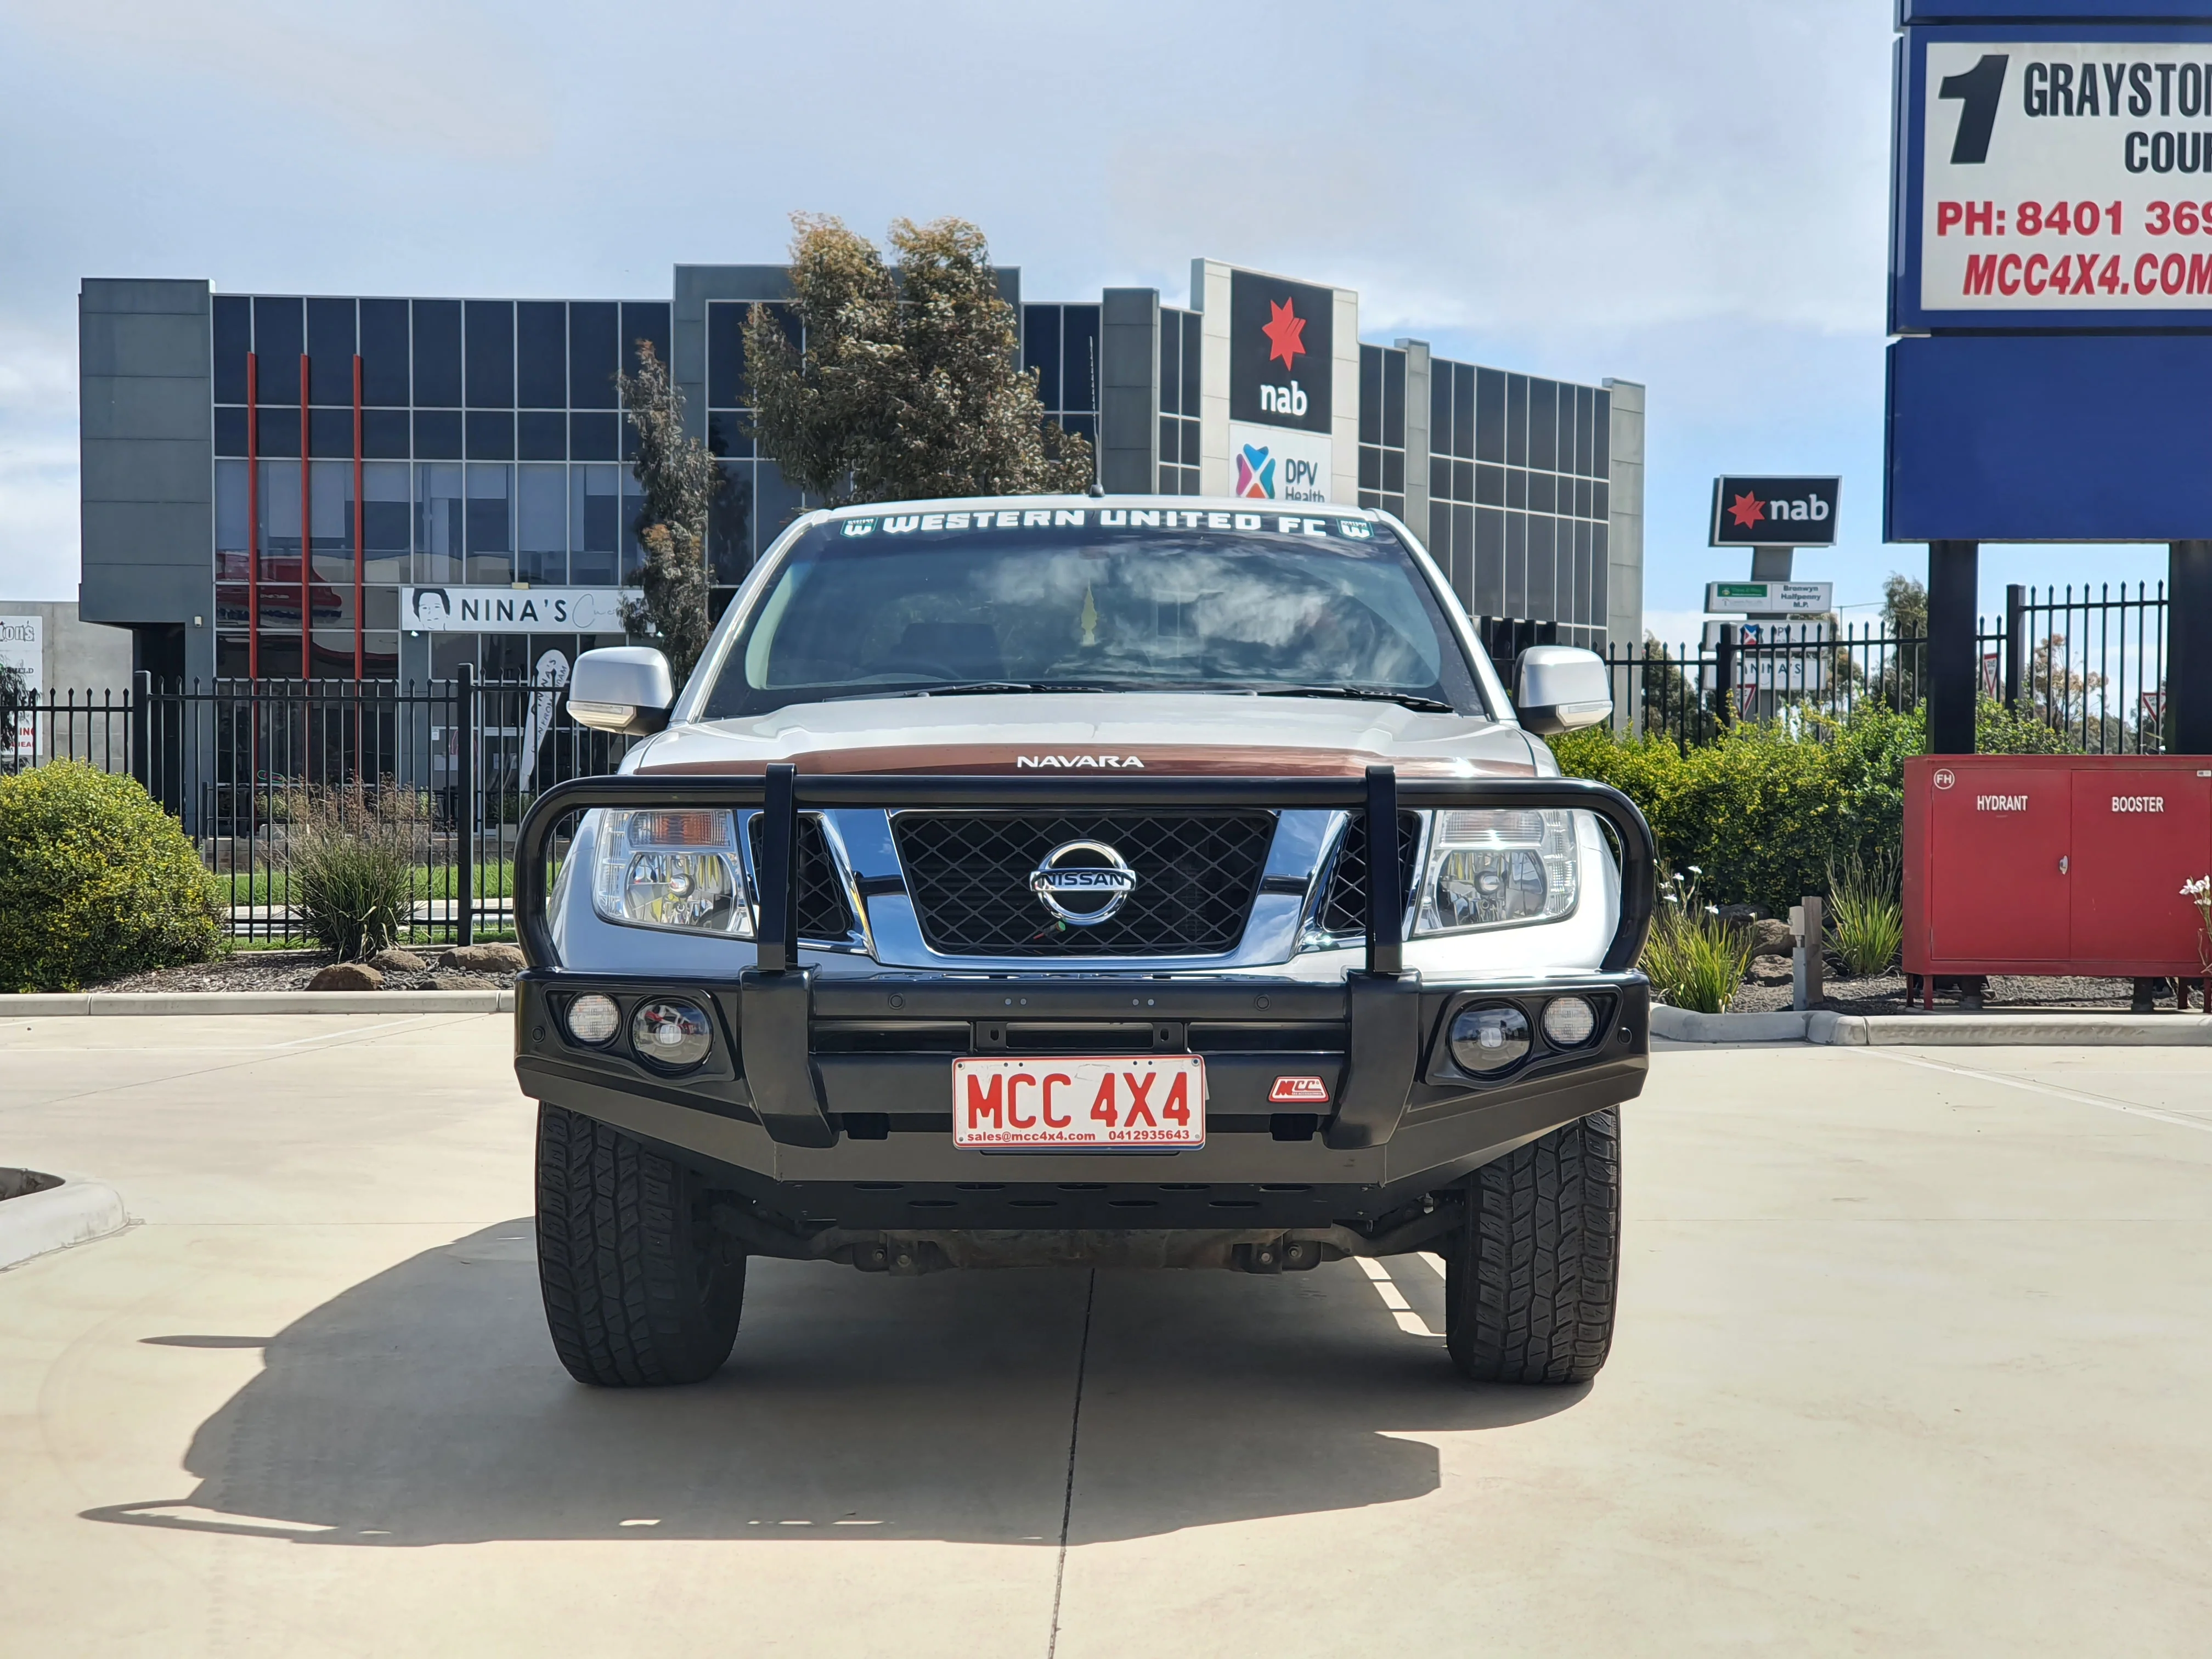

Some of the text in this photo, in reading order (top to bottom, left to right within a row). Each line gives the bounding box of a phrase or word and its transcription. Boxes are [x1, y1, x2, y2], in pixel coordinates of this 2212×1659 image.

[1938, 54, 2010, 165] 1
[1937, 201, 2006, 236] PH:
[2016, 201, 2123, 236] 8401
[1962, 253, 2212, 296] MCC4X4.COM
[1261, 380, 1307, 416] nab
[1285, 458, 1318, 487] DPV
[1285, 486, 1325, 503] Health
[1770, 494, 1829, 521] nab
[883, 509, 1327, 537] WESTERN UNITED FC
[461, 598, 567, 623] NINA'S
[1017, 755, 1145, 768] NAVARA
[1937, 774, 1952, 783] FH
[1977, 795, 2028, 811] HYDRANT
[2112, 796, 2164, 812] BOOSTER
[1042, 873, 1125, 886] NISSAN
[967, 1071, 1191, 1129] MCC 4X4
[967, 1130, 1190, 1142] sales@mcc4x4.com 0412935643
